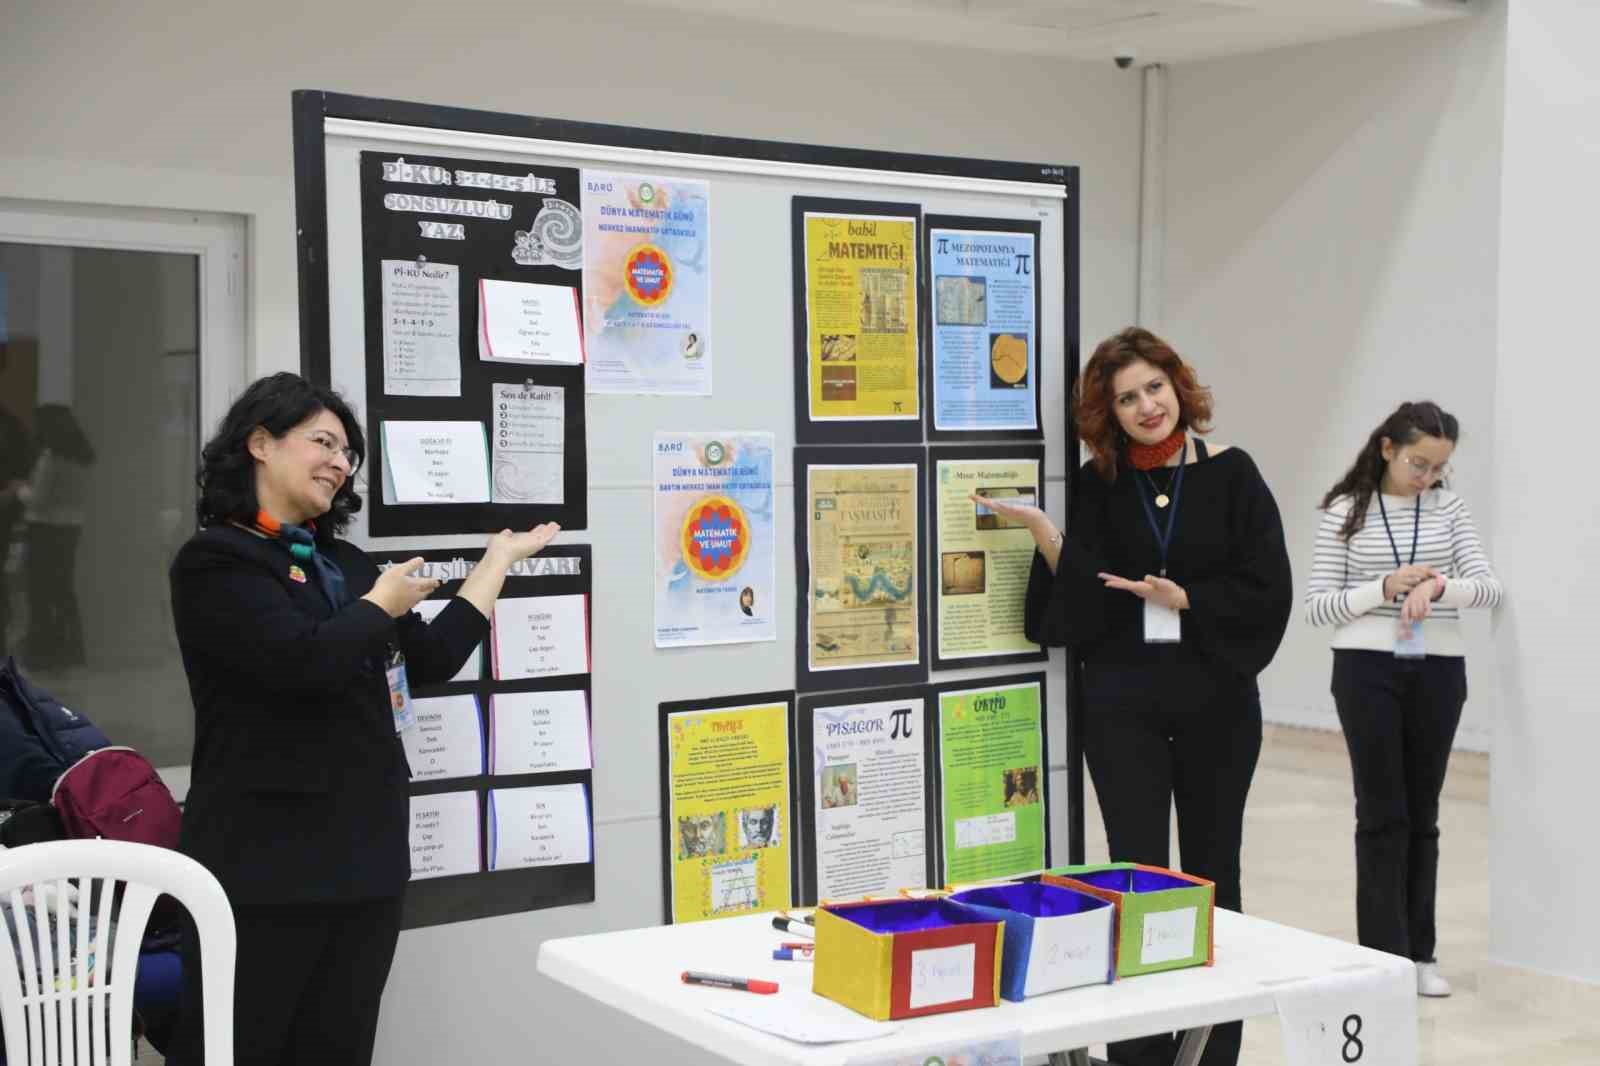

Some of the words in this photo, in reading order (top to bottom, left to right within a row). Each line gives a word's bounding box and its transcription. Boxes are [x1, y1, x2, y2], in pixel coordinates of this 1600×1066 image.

[384, 193, 513, 221] SONSUZLUĞU
[847, 221, 878, 237] babil
[505, 557, 581, 577] UVARI
[1341, 1013, 1365, 1064] 8
